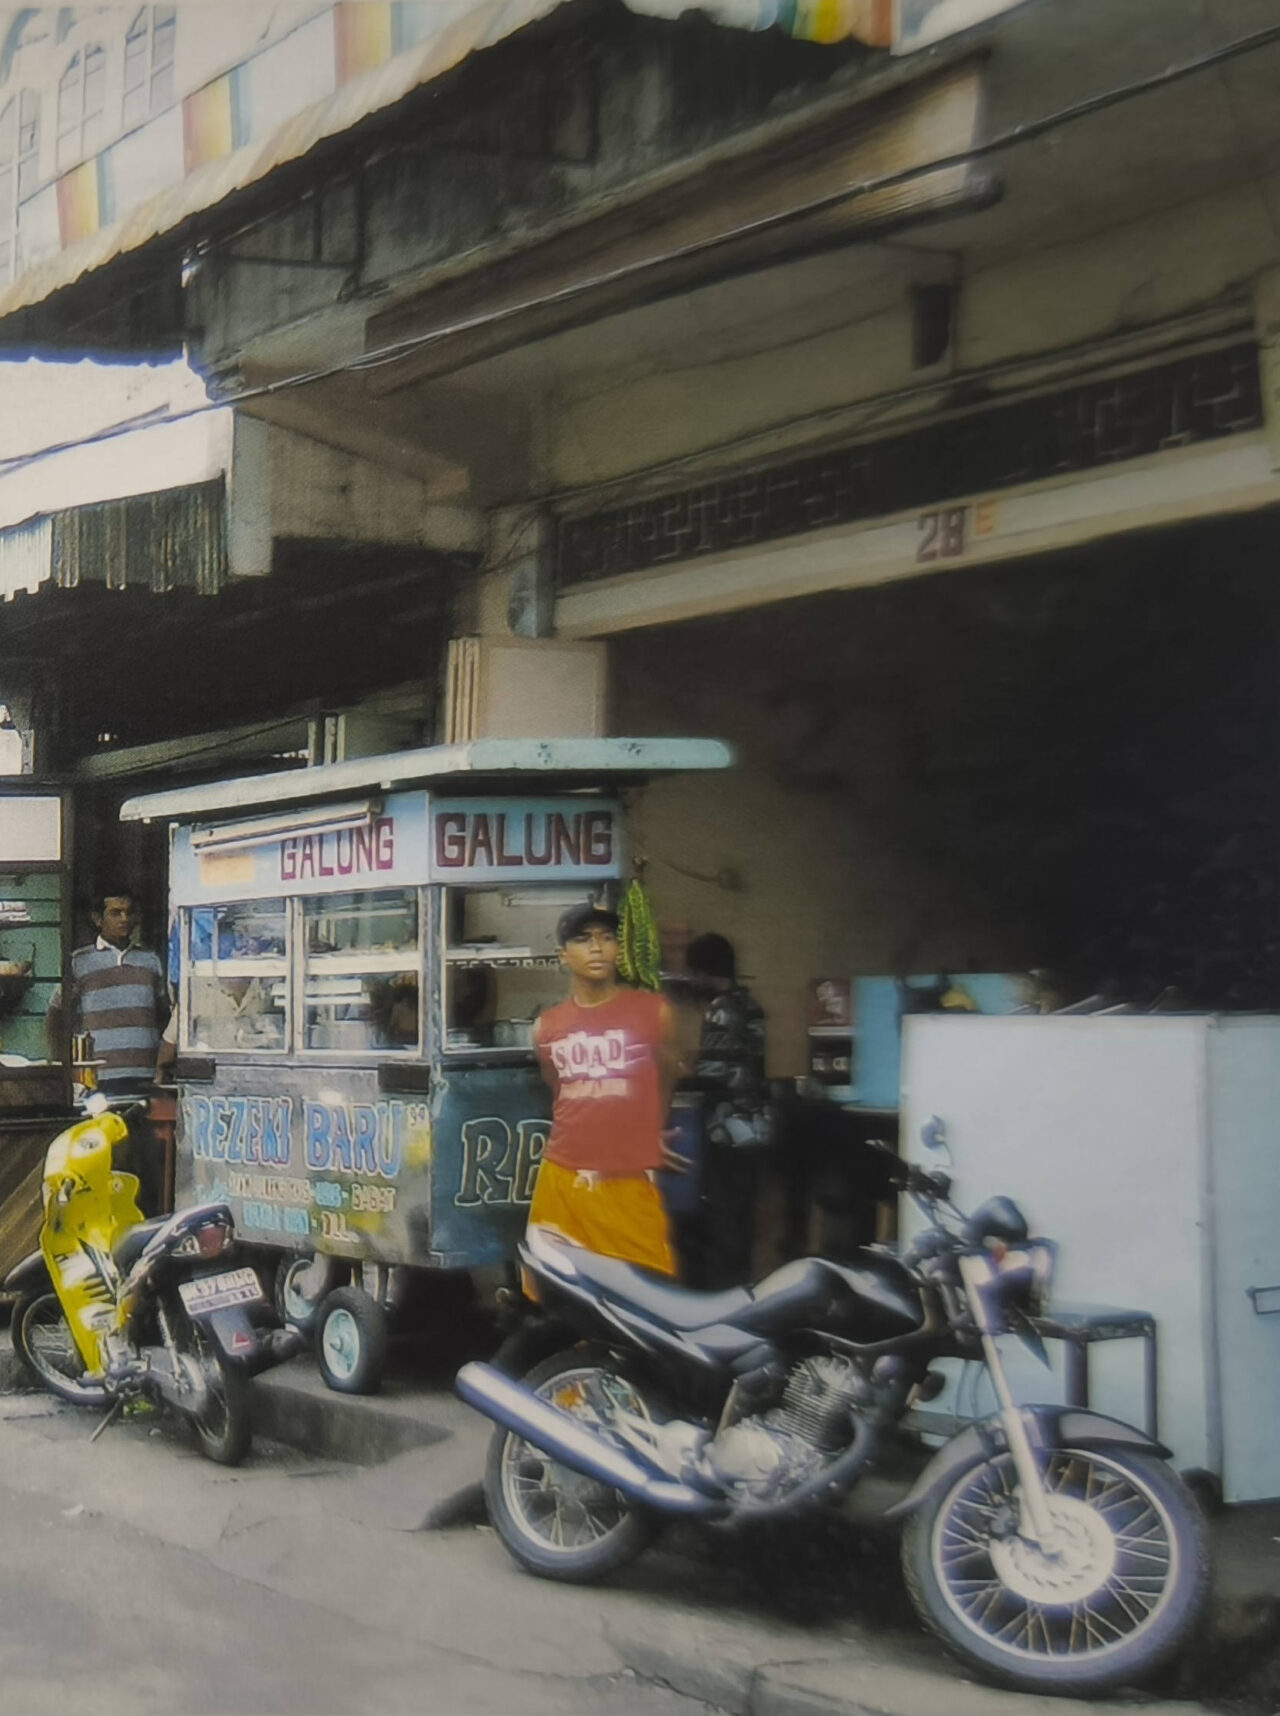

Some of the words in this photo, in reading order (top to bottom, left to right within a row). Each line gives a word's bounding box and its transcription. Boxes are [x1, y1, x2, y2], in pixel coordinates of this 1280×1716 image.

[280, 817, 395, 880] GALUNG
[435, 811, 614, 868] GALUNG
[554, 1037, 623, 1071] SOAD
[192, 1096, 292, 1168] REZEKI
